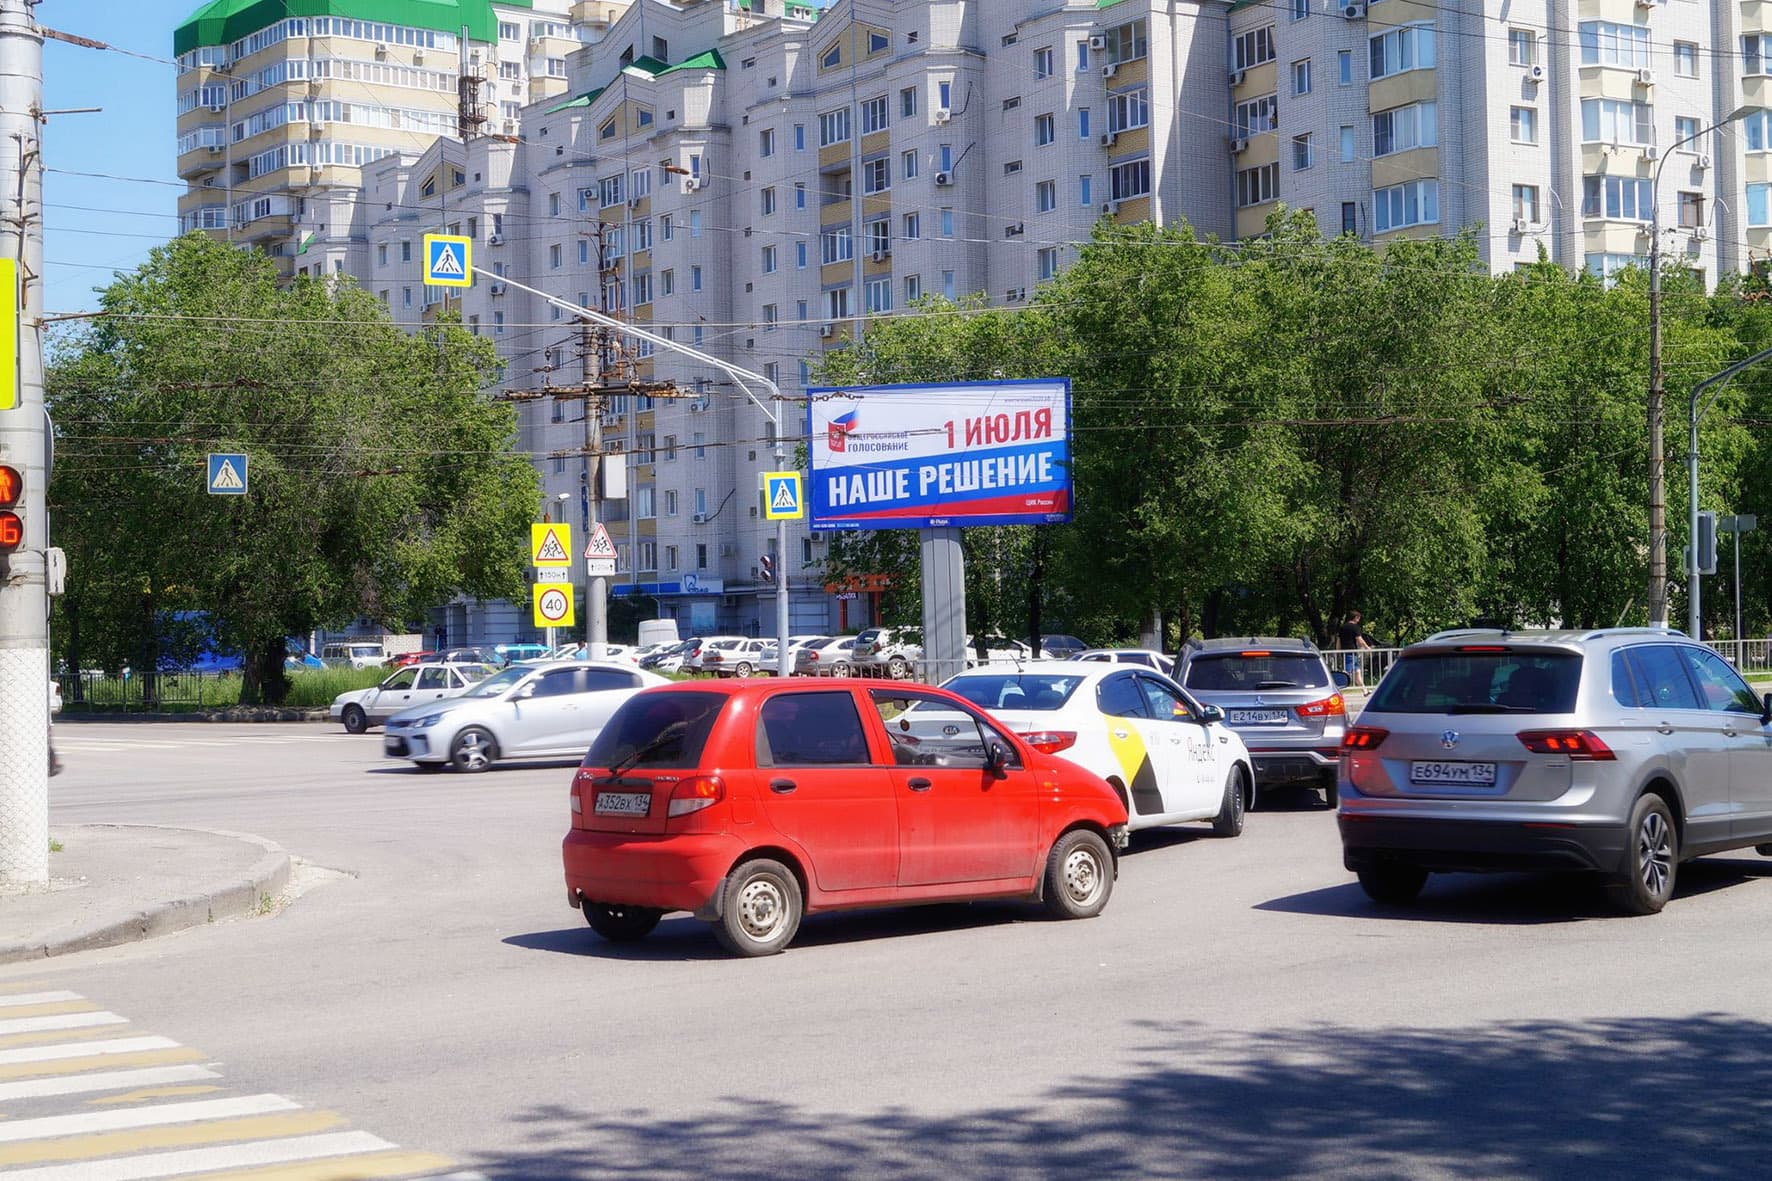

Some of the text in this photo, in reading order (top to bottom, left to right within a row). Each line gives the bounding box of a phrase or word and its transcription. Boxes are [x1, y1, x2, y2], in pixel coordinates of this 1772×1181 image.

[944, 407, 1052, 448] 1 ИЮЛЯ
[848, 441, 909, 452] ГОЛОСОВАНИЕ
[829, 451, 1053, 507] НАШЕ РЕШЕНИЕ
[545, 598, 562, 611] 40
